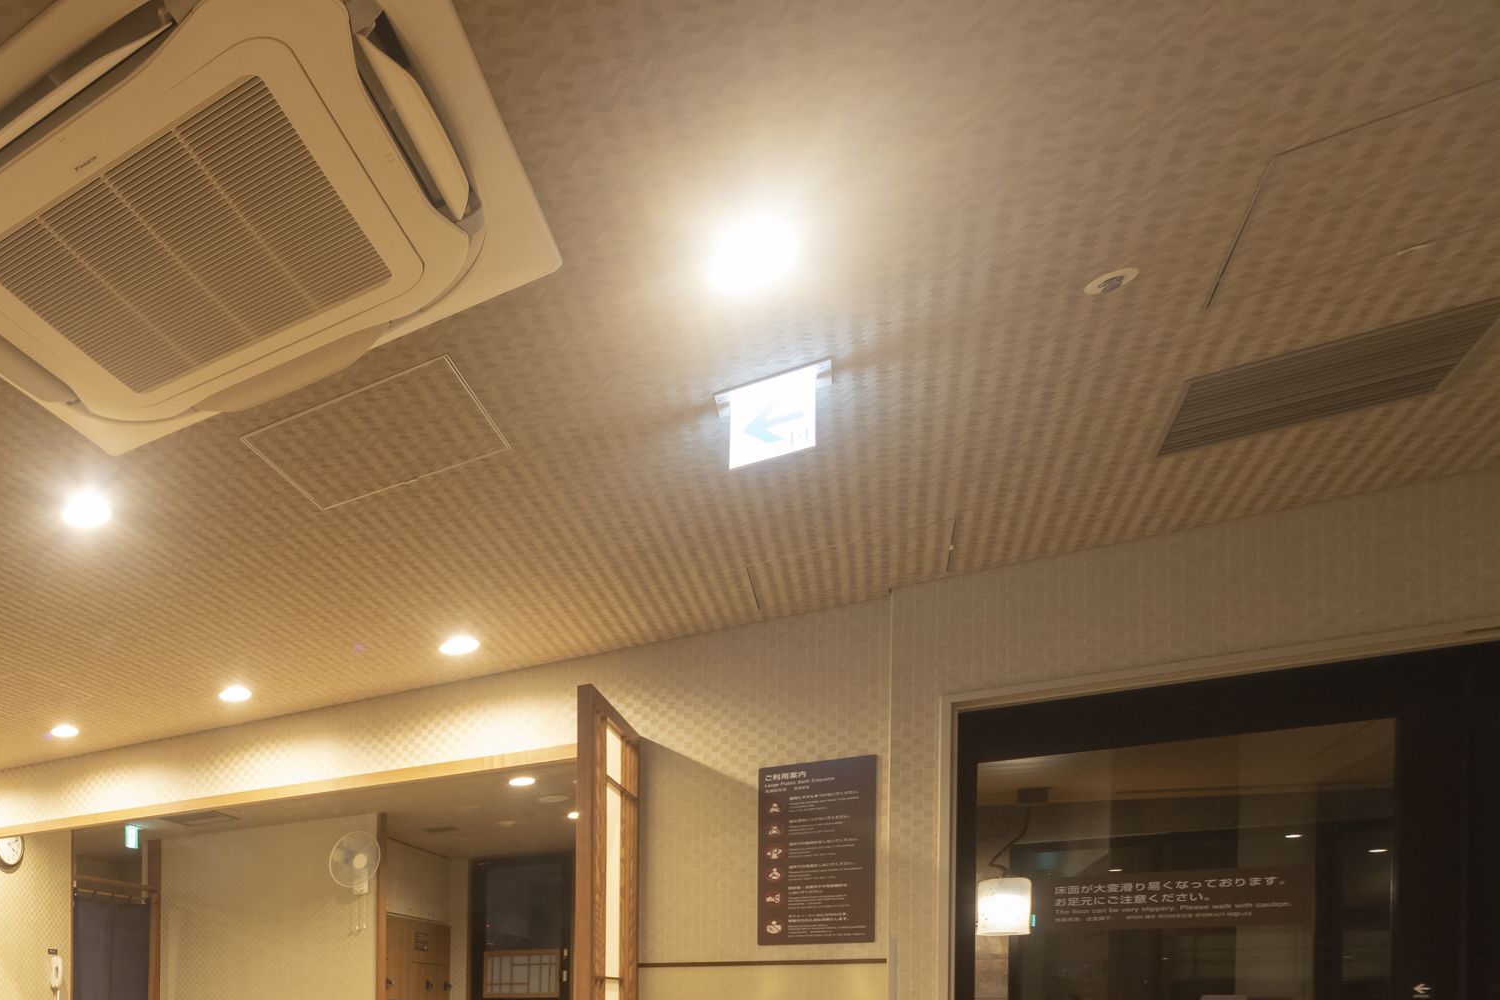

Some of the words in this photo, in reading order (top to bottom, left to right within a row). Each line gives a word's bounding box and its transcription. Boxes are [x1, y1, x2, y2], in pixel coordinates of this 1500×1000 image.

[764, 771, 807, 782] ご利用案内
[1054, 876, 1285, 896] 床面が大変滑り易くなっております。
[1054, 892, 1211, 907] お足元にご注意ください。
